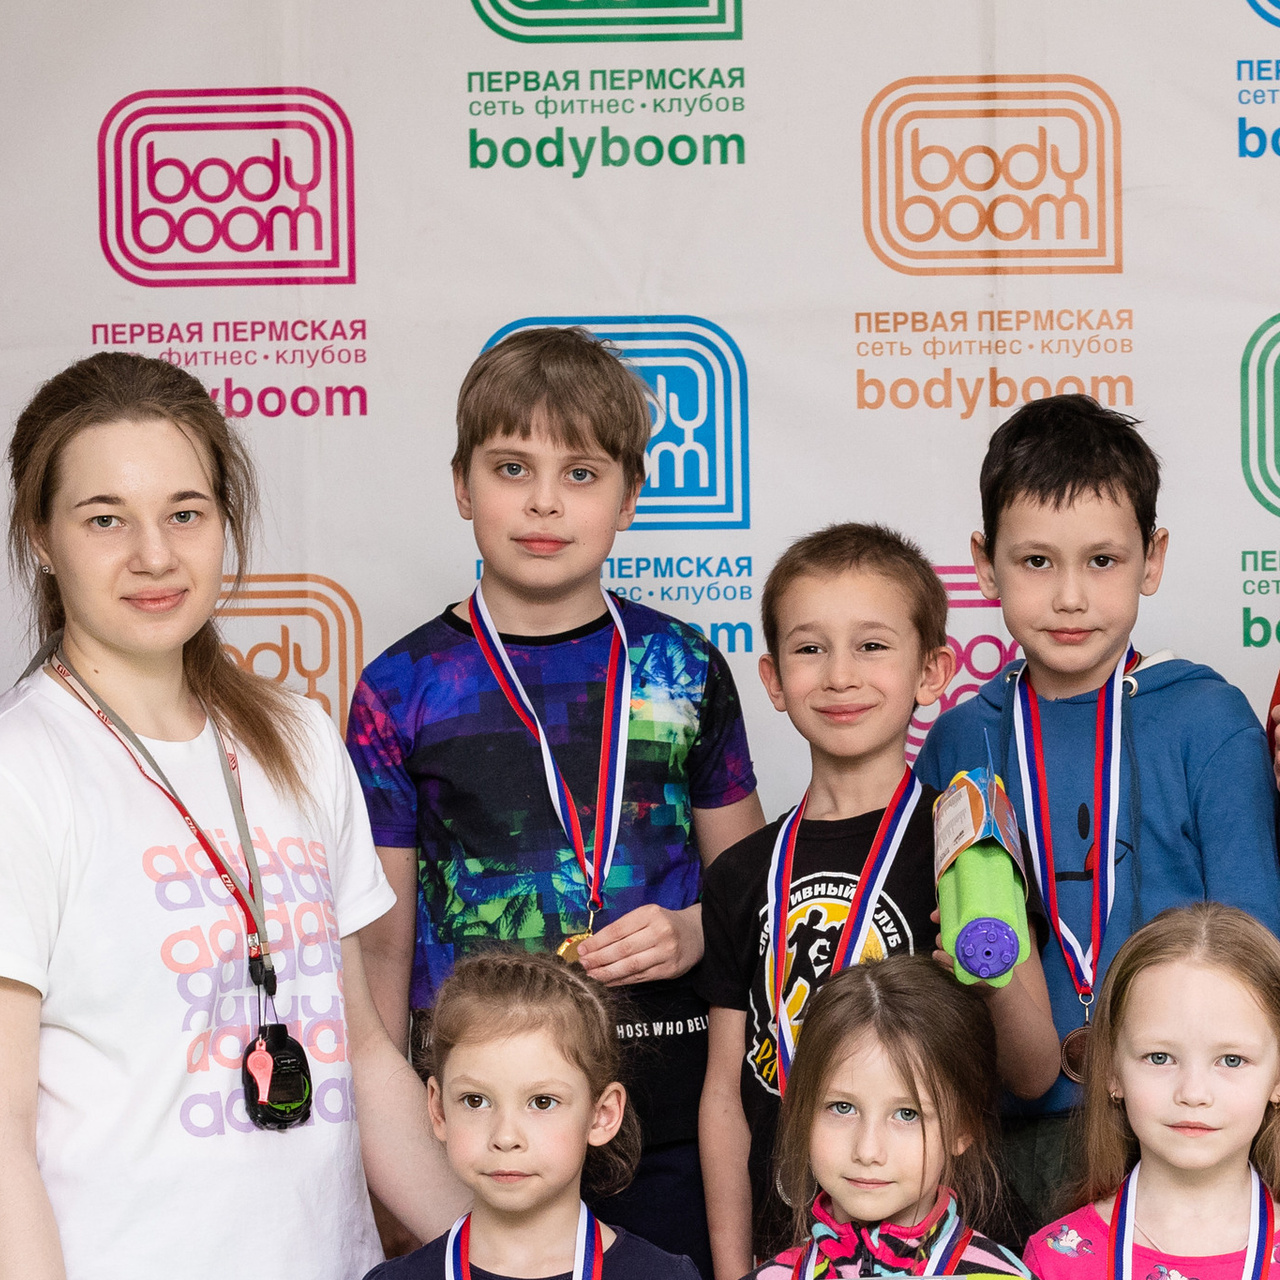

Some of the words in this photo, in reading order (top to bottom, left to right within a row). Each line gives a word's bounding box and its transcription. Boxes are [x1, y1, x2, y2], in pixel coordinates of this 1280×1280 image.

[468, 70, 579, 93] ПЕРВАЯ
[590, 67, 745, 91] ПЕРМСКАЯ
[469, 98, 523, 116] сеть
[146, 138, 321, 203] body
[468, 126, 746, 179] bodyboom
[911, 125, 1089, 191] body
[131, 204, 323, 255] boom
[895, 192, 1091, 243] boom
[92, 322, 203, 345] ПЕРВАЯ
[213, 319, 367, 343] ПЕРМСКАЯ
[855, 311, 968, 333] ПЕРВАЯ
[978, 309, 1134, 332] ПЕРМСКАЯ
[856, 340, 912, 357] сеть
[209, 377, 368, 418] boom
[856, 367, 1134, 420] bodyboom
[600, 556, 752, 579] ПЕРМСКАЯ
[142, 826, 330, 883] adidas
[160, 893, 339, 974] addas
[616, 1023, 649, 1038] HOSE
[653, 1021, 683, 1036] WHO
